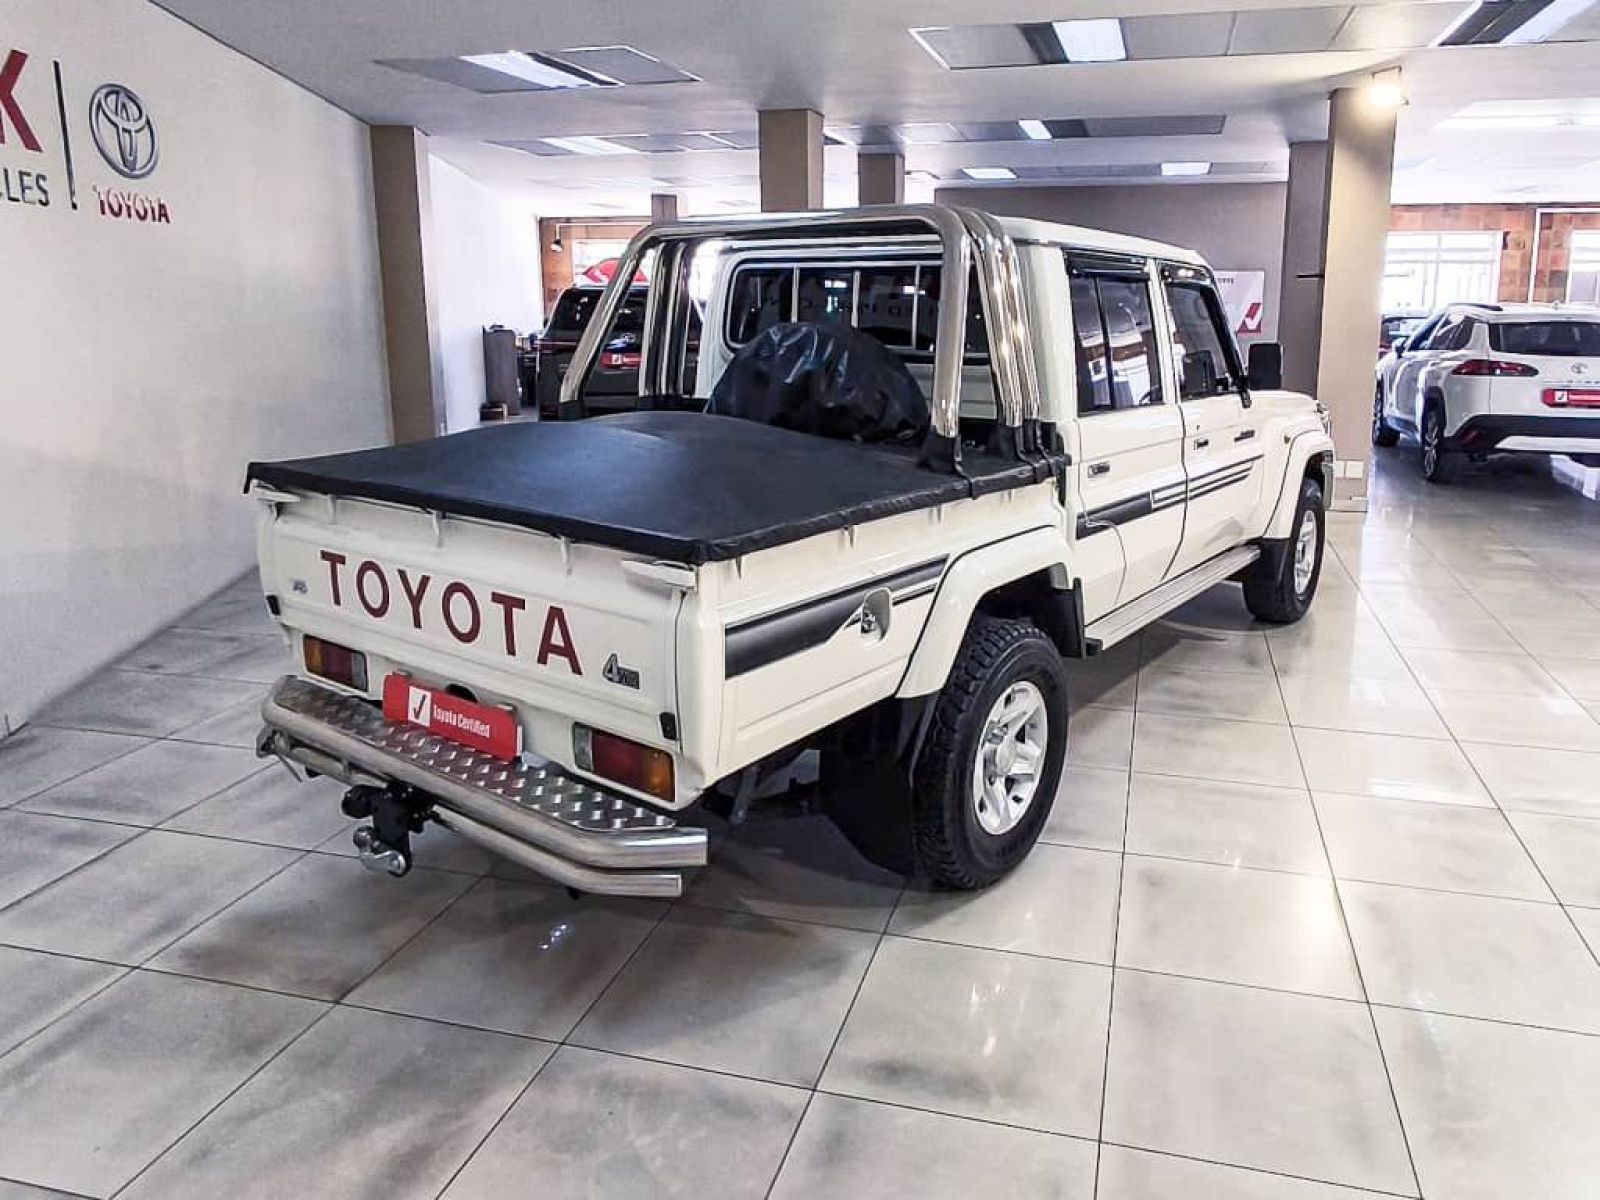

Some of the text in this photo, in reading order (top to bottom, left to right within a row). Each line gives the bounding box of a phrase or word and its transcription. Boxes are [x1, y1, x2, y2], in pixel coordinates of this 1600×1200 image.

[0, 167, 50, 206] LES
[93, 186, 170, 224] TOYOTA
[320, 550, 583, 676] TOYOTA
[432, 704, 490, 739] Toyota Certified
